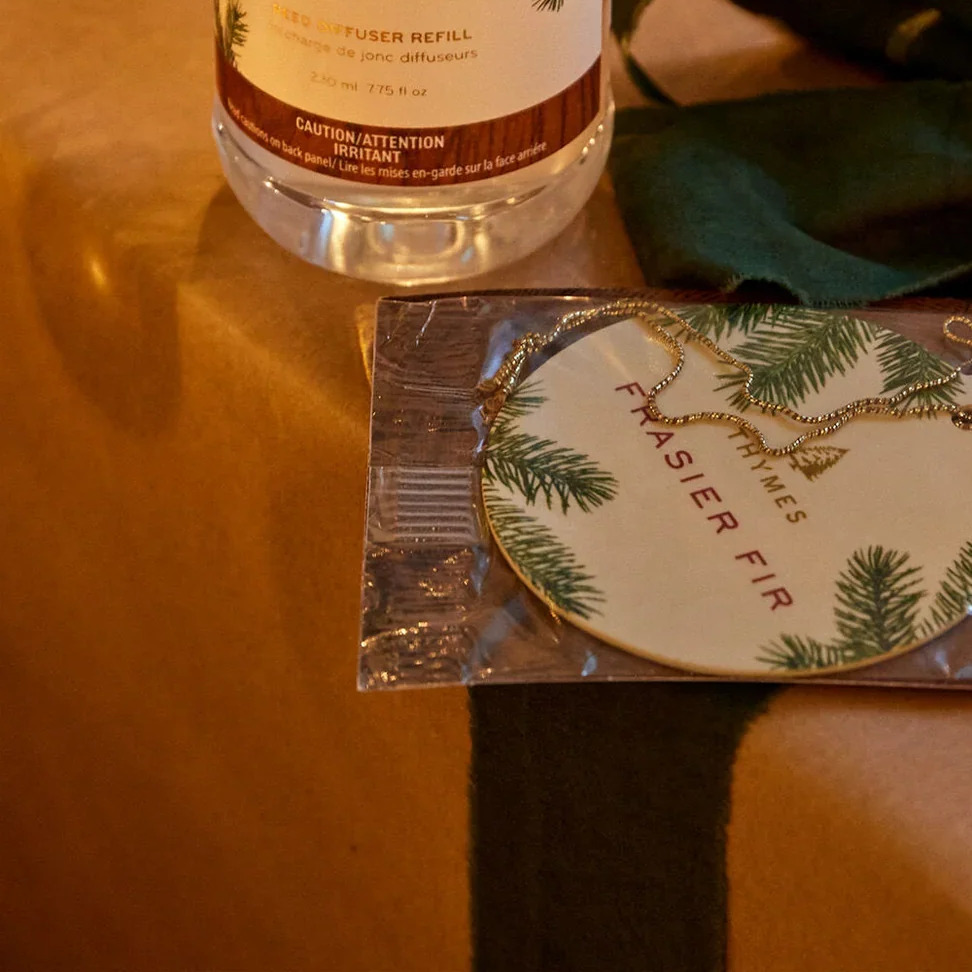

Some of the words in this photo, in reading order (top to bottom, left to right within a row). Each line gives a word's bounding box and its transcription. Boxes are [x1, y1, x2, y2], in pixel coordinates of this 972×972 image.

[411, 28, 472, 44] REFILL
[336, 45, 356, 59] de
[360, 50, 394, 63] jonc
[399, 48, 478, 64] diffuseurs
[341, 81, 358, 92] ml
[399, 86, 408, 96] fl
[412, 88, 428, 97] oz
[295, 116, 445, 149] CAUTION/ATTENTION
[282, 139, 303, 158] back
[304, 152, 337, 169] panel/
[338, 159, 359, 173] Lire
[361, 163, 376, 177] les
[378, 166, 410, 178] mises
[412, 164, 463, 181] en-garde
[465, 162, 482, 174] sur
[483, 158, 493, 171] la
[495, 154, 516, 169] face
[333, 143, 402, 164] IRRITANT
[727, 427, 808, 525] THYMES
[615, 381, 739, 535] FRASIER
[735, 549, 794, 611] FIR
